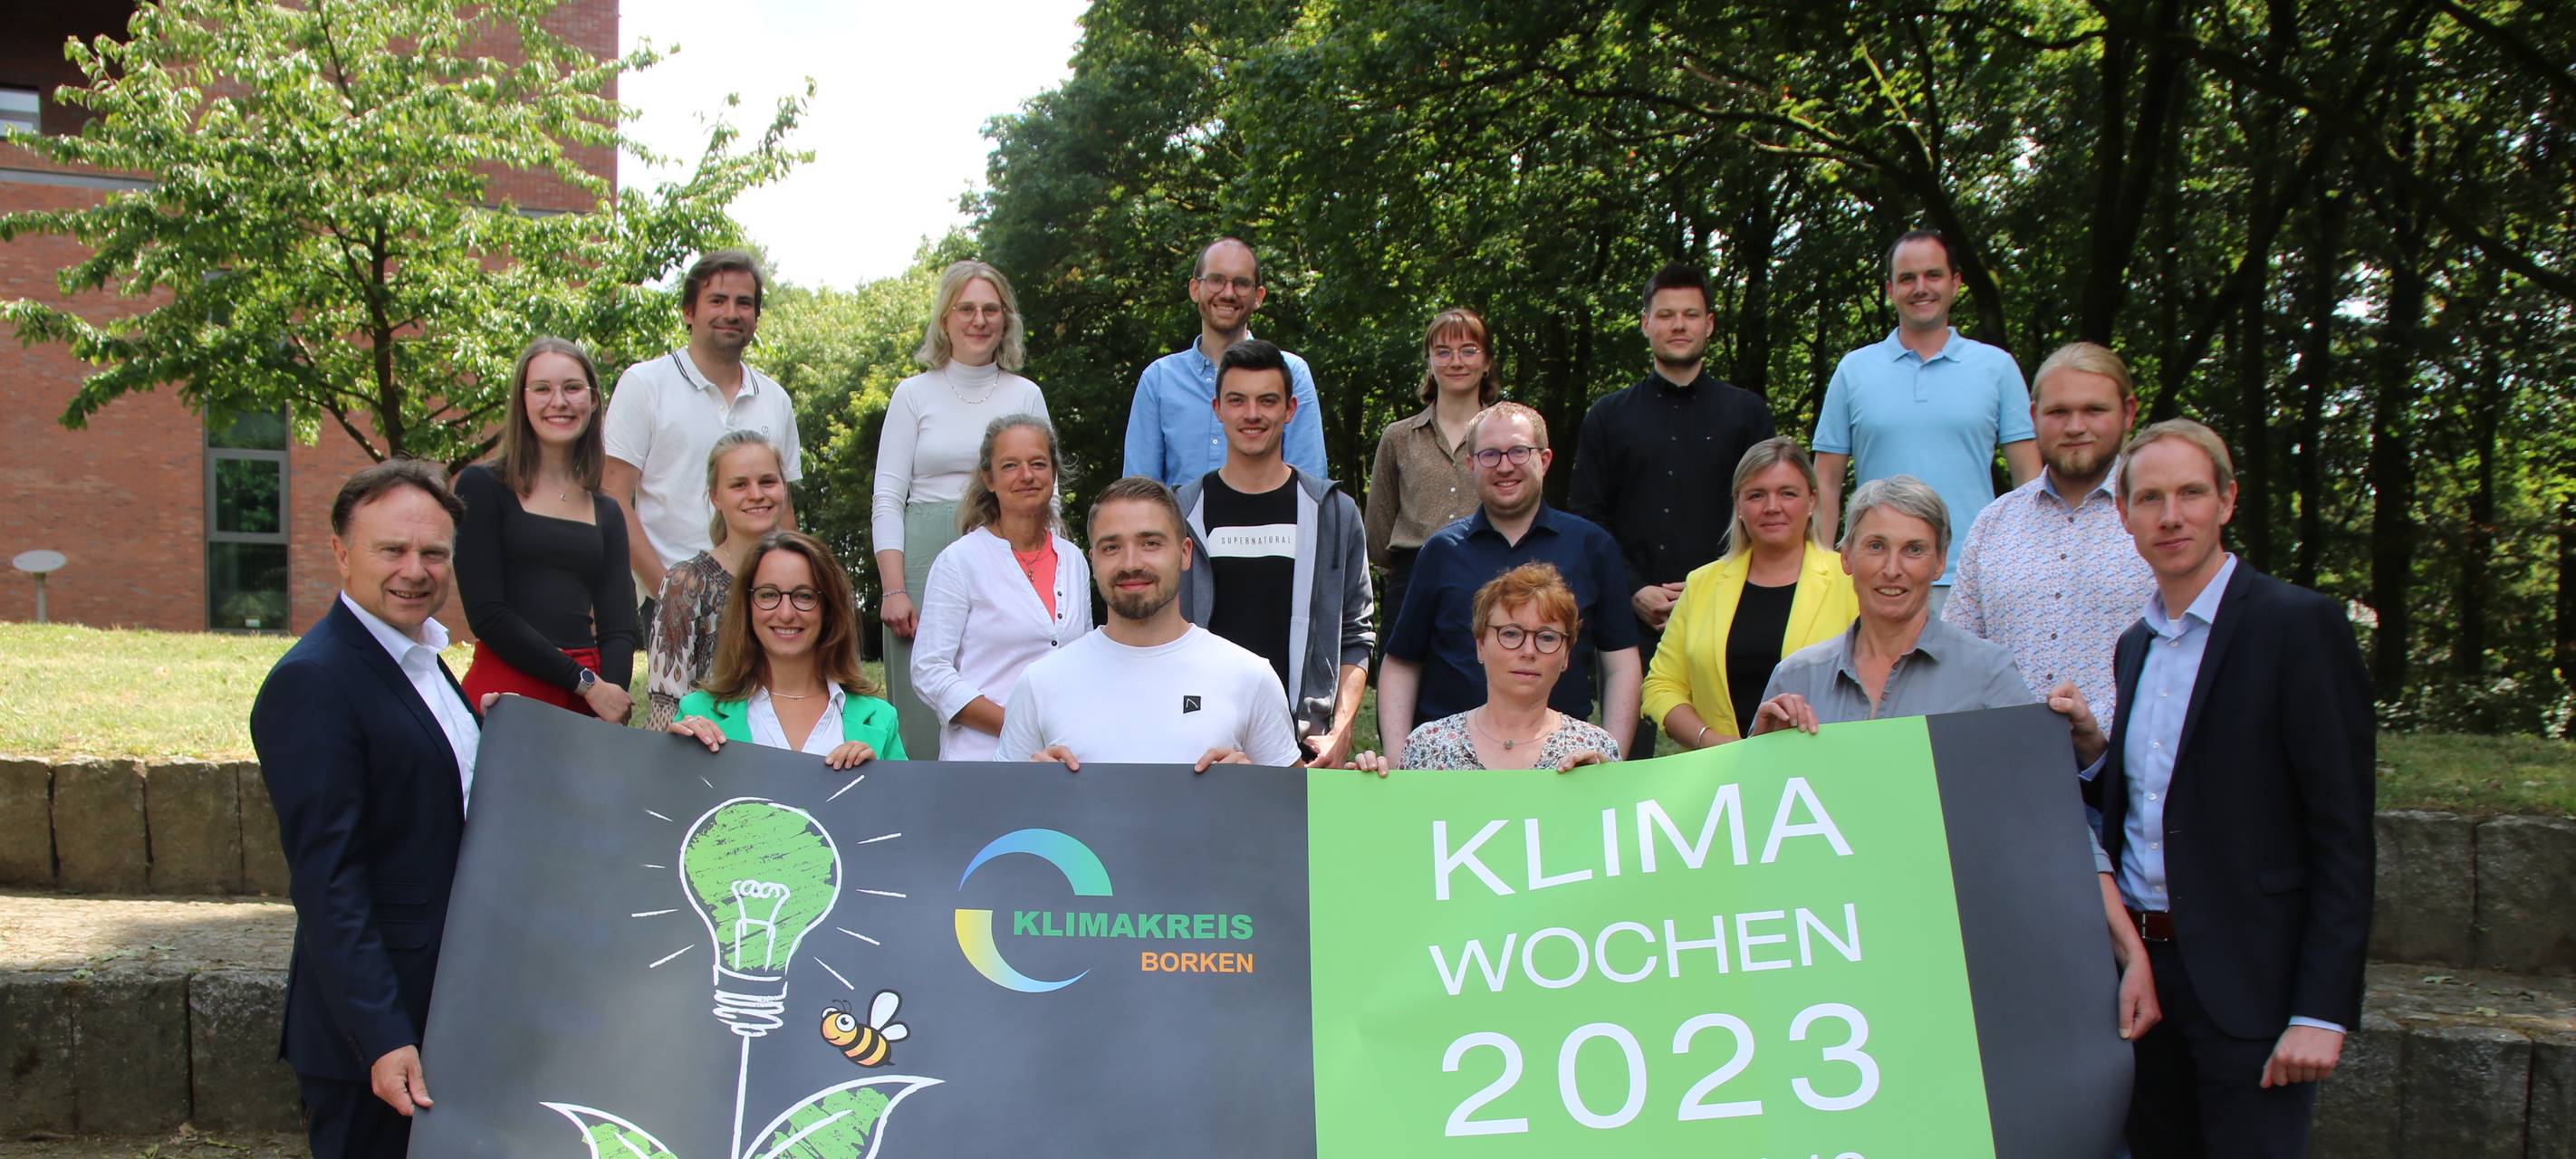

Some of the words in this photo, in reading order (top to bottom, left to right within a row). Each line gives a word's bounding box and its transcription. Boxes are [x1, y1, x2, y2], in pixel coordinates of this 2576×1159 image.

[1221, 535, 1291, 544] SUPERNATURAL
[1432, 776, 1854, 901] KLIMA
[1014, 910, 1254, 940] KLIMAKREIS
[1428, 903, 1862, 995] WOCHEN
[1141, 952, 1254, 973] BORKEN
[1442, 1002, 1880, 1136] 2023
